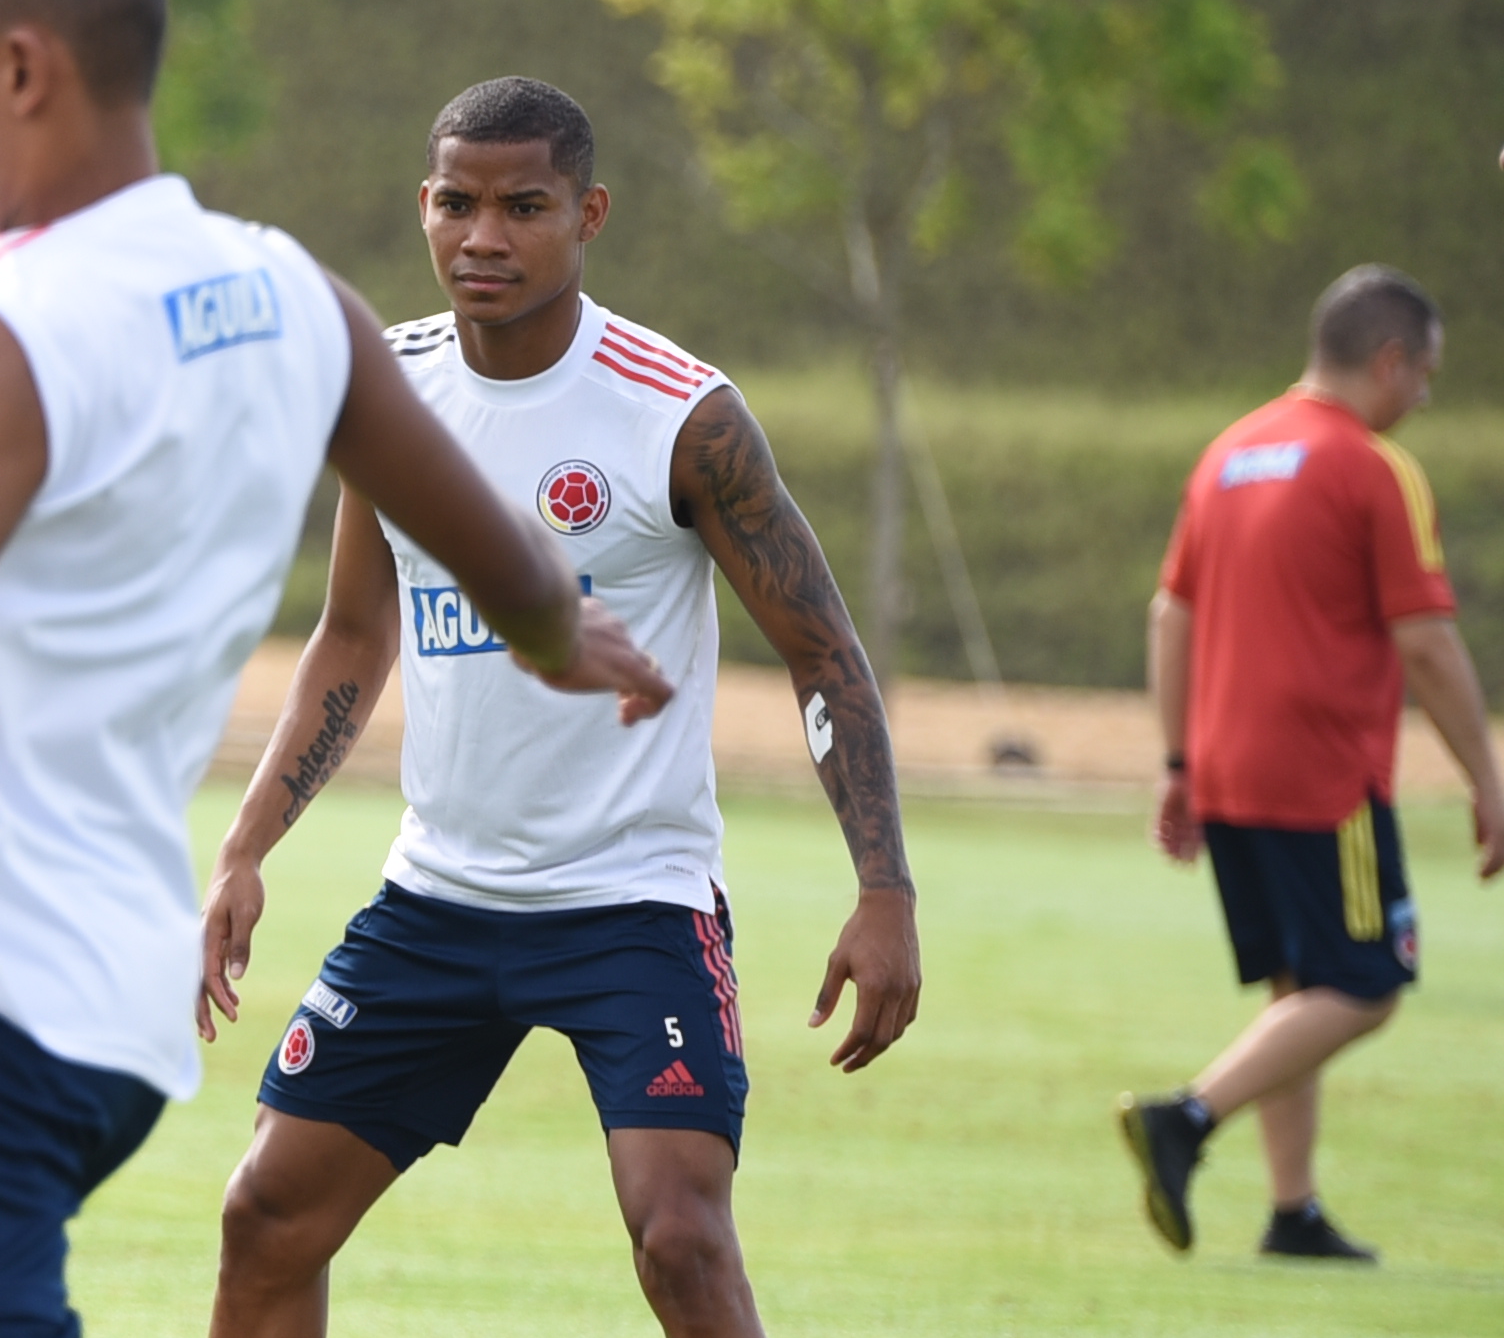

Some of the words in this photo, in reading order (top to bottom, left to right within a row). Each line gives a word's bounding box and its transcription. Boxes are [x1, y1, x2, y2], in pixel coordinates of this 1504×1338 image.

[420, 591, 506, 651] AGU
[283, 678, 360, 827] Antonella
[664, 1016, 684, 1048] 5
[646, 1083, 705, 1098] adidas
